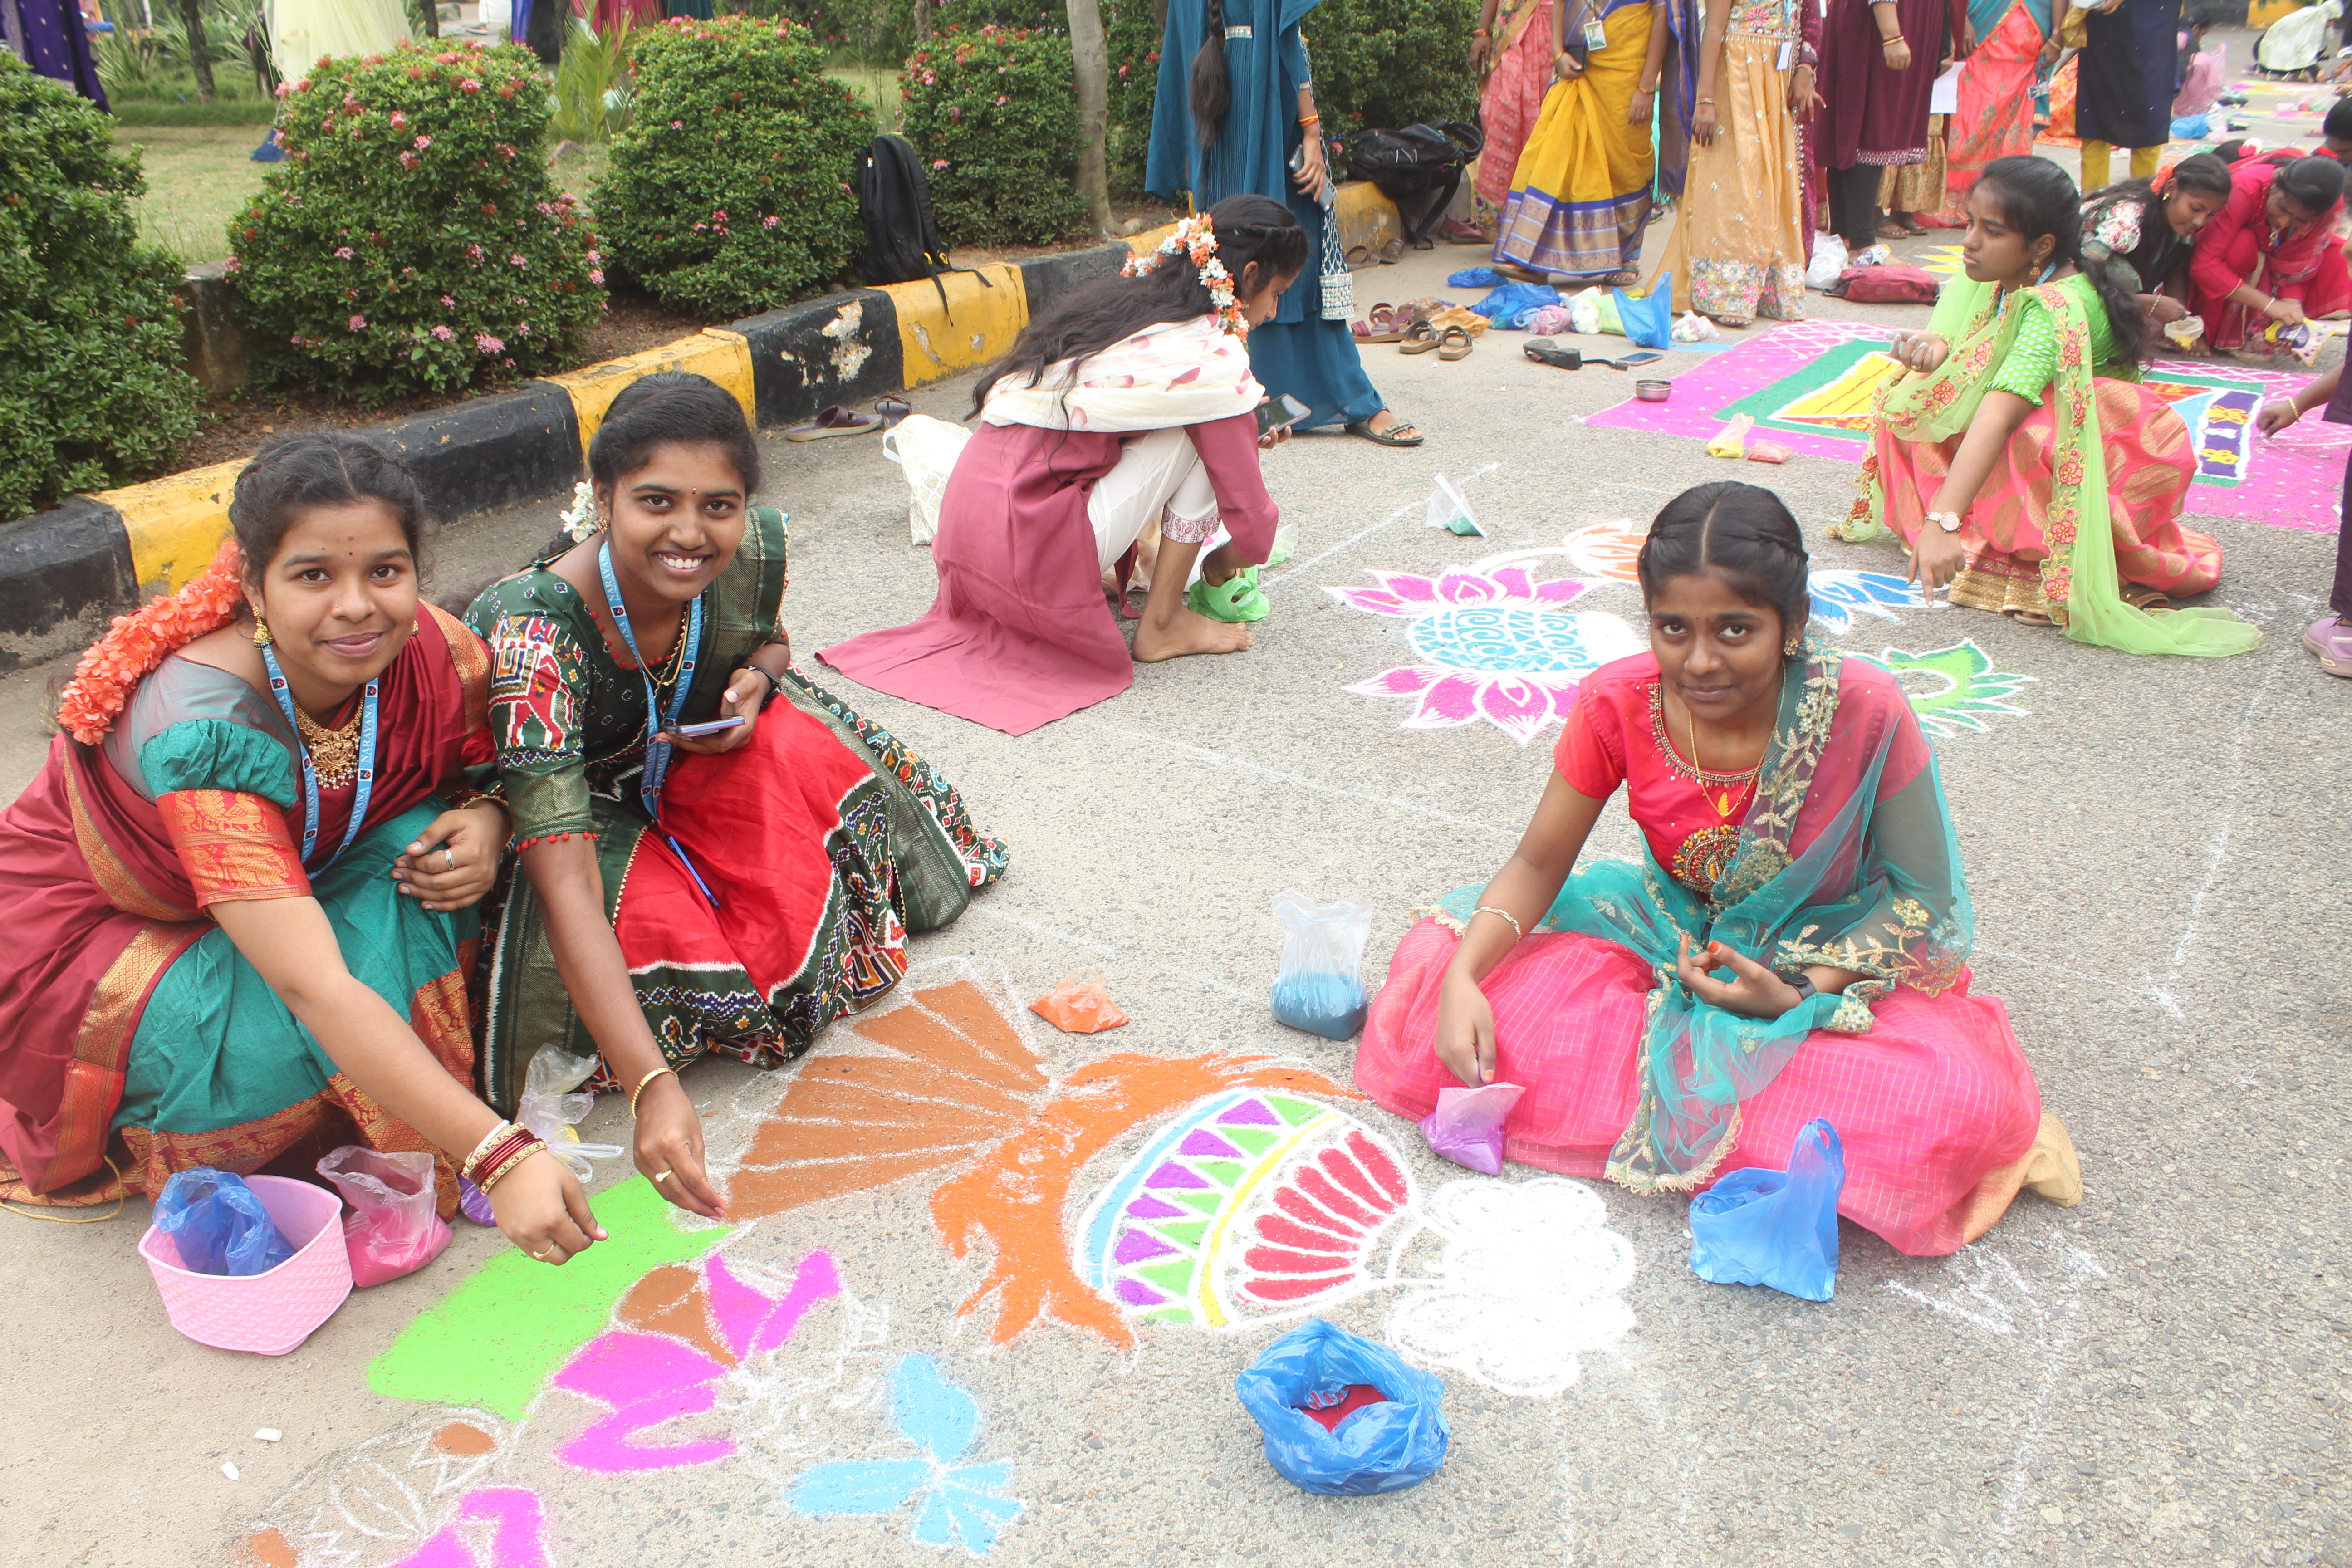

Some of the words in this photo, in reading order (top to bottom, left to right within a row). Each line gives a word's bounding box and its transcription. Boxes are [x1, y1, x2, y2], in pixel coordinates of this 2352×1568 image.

[599, 548, 617, 601] NARAYANA
[686, 604, 698, 656] NARAYANA
[667, 675, 688, 715] NARAYANA
[360, 703, 374, 763] NARAYANA
[642, 746, 655, 783] NARAYANA
[655, 743, 667, 781] NARAYA
[306, 773, 314, 826] NARAYANA
[345, 787, 368, 839] NARAYANA
